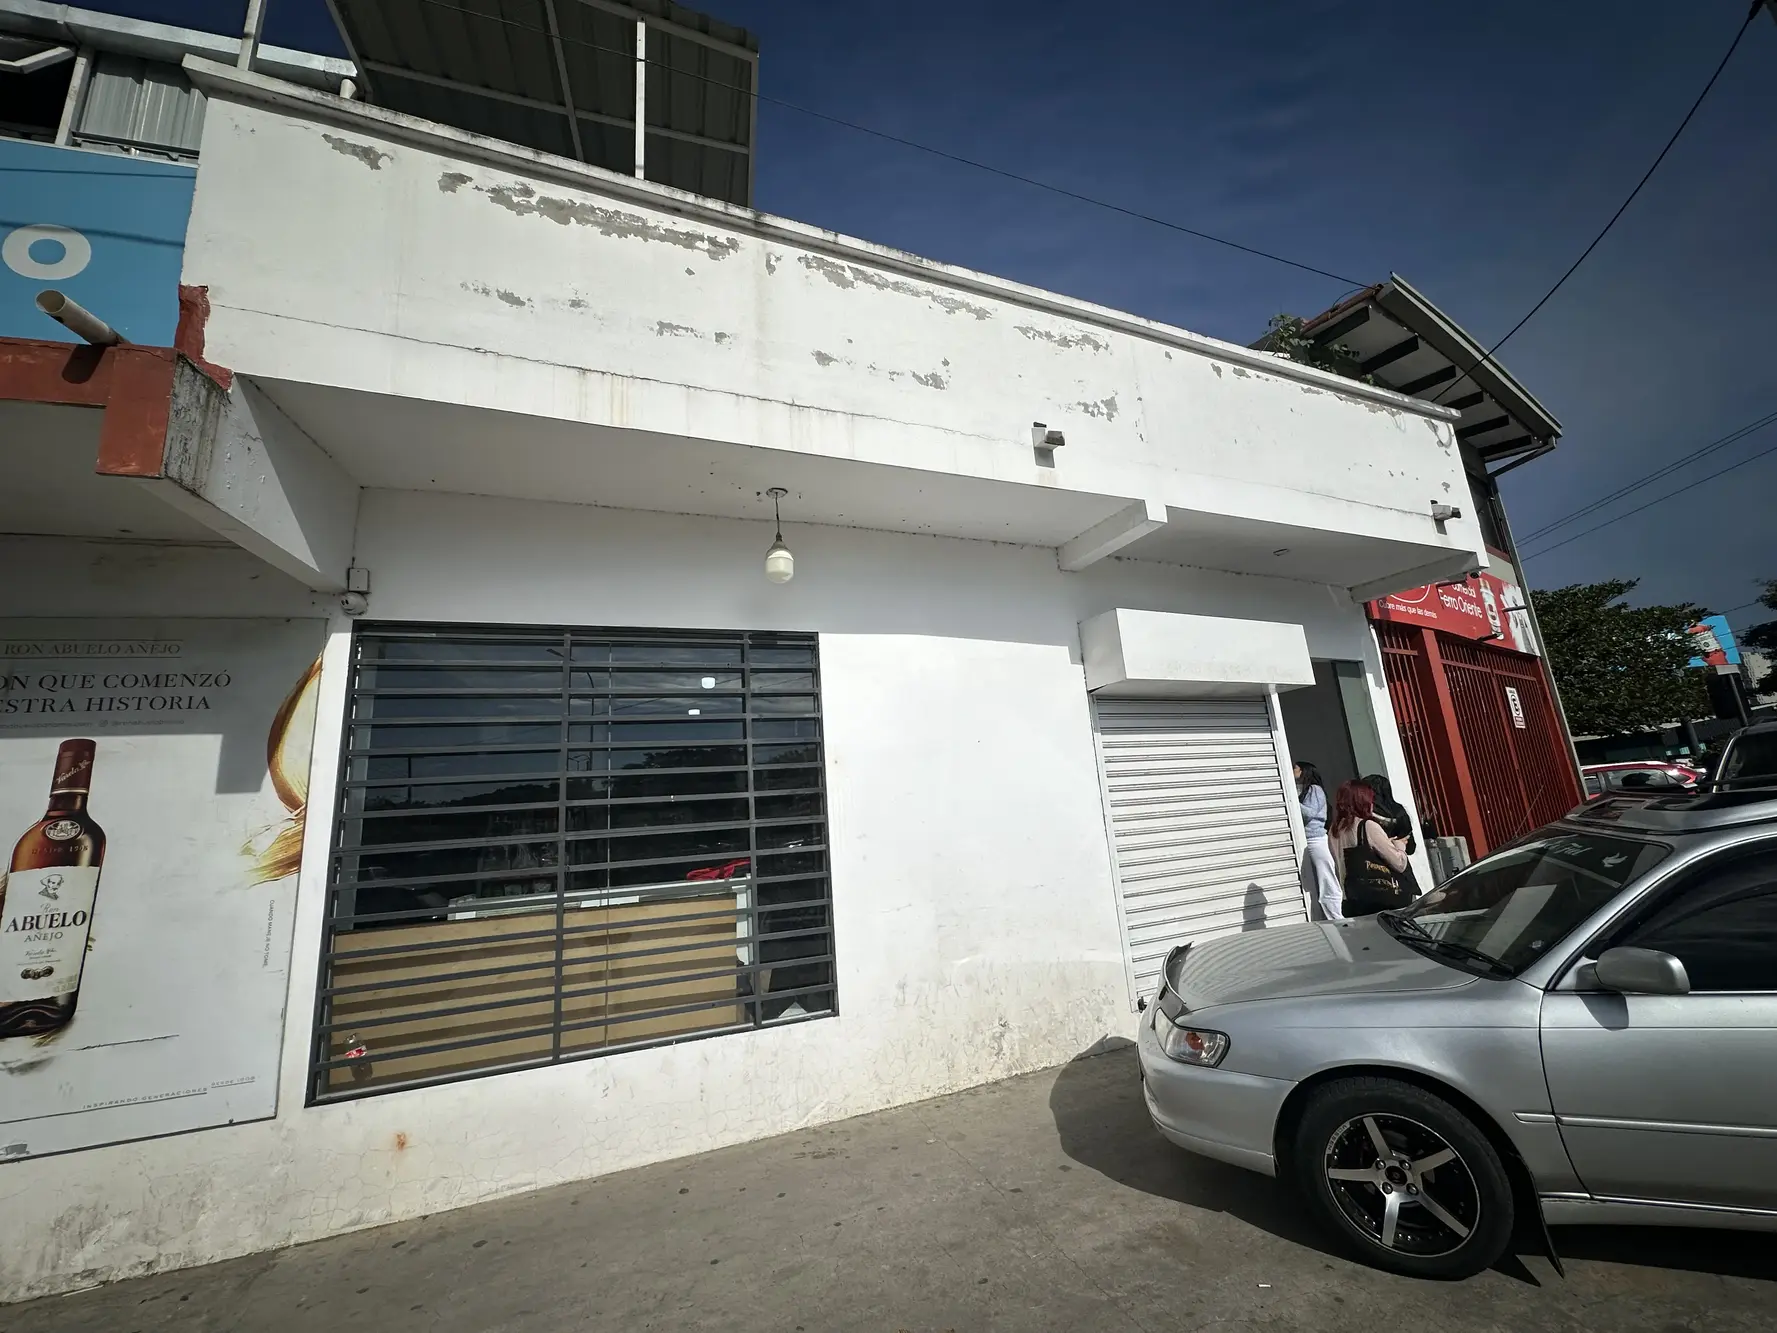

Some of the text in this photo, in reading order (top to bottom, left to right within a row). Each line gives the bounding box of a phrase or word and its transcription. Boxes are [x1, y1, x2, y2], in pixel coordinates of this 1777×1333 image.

[1407, 606, 1416, 615] que
[1416, 606, 1424, 616] las
[1458, 596, 1483, 619] Oriente
[5, 641, 180, 655] RON ABUELO AÑEJO
[38, 674, 96, 692] QUE
[103, 669, 231, 689] COMENZÓ
[84, 695, 211, 712] HISTORIA
[4, 910, 87, 933] ABUELO
[24, 931, 63, 943] AÑEJO
[82, 1087, 208, 1110] INSPIRANDO GENERACIONES
